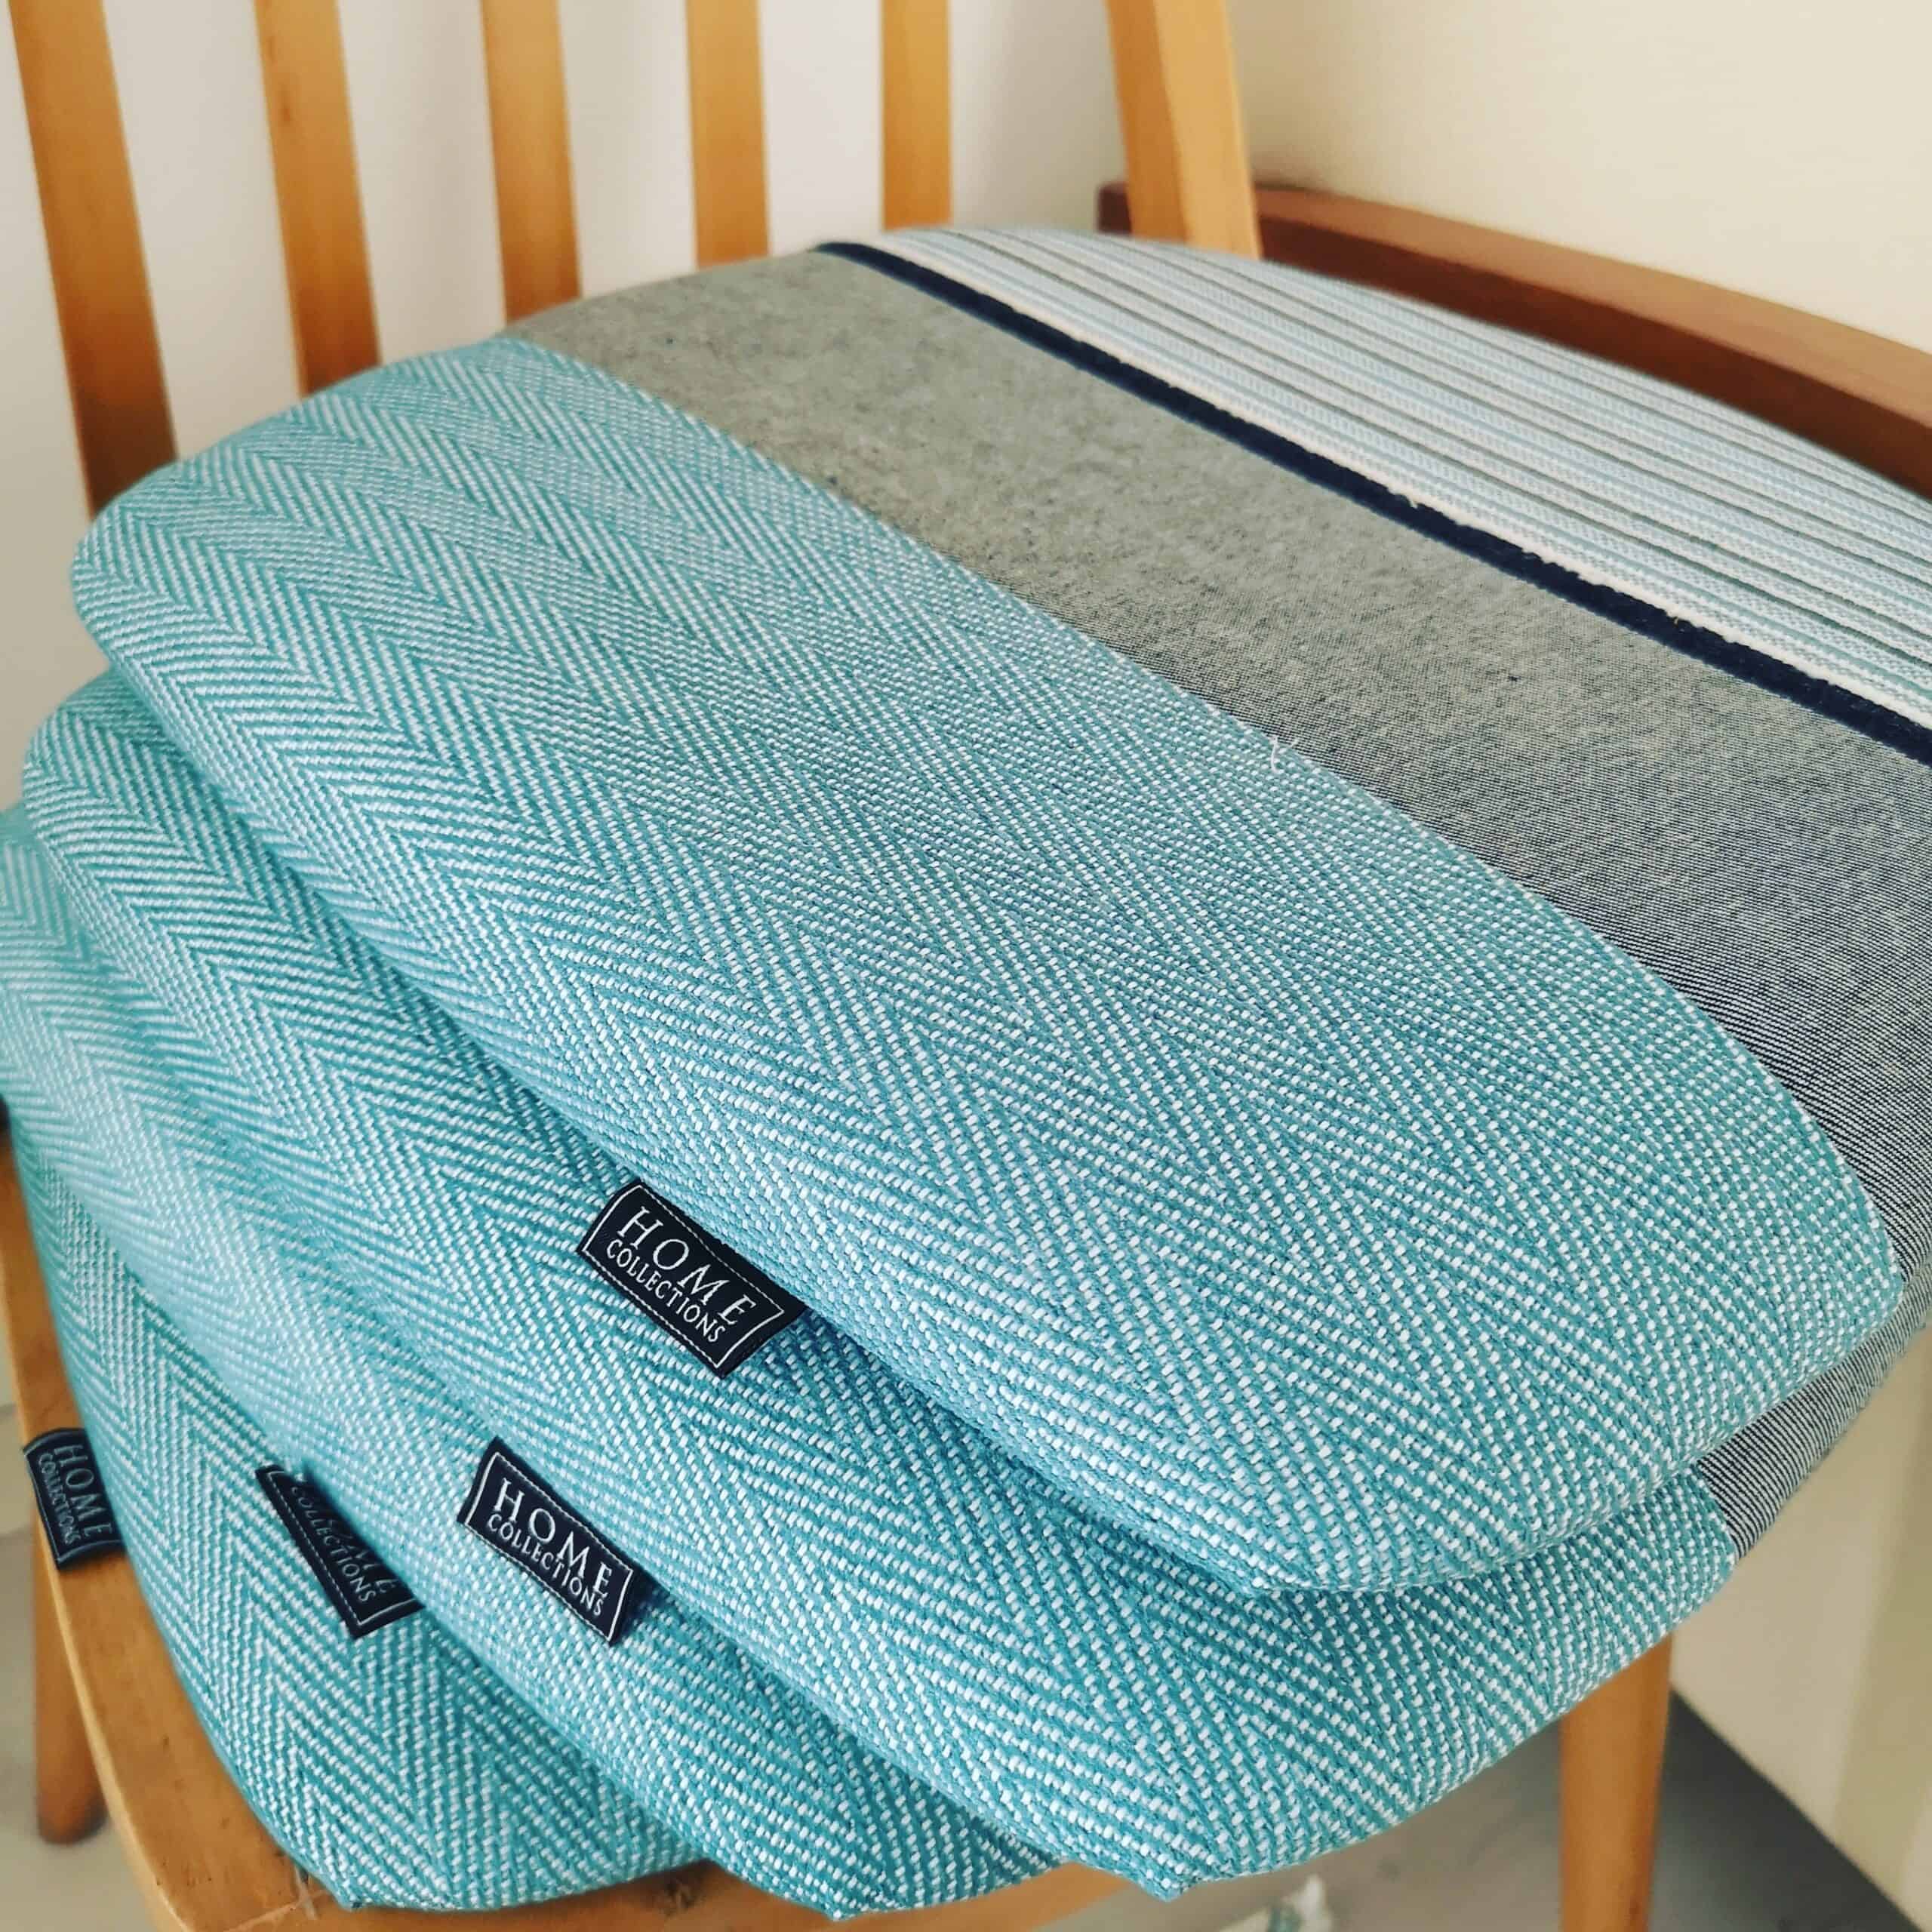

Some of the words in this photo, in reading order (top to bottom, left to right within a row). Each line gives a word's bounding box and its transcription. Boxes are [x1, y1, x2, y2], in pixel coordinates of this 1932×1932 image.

[607, 1239, 725, 1343] COLLECTIONS
[617, 1206, 756, 1325] HOME
[54, 1444, 112, 1537] HOME
[494, 1478, 612, 1598] HOME
[488, 1514, 604, 1616] COLLECTIONS
